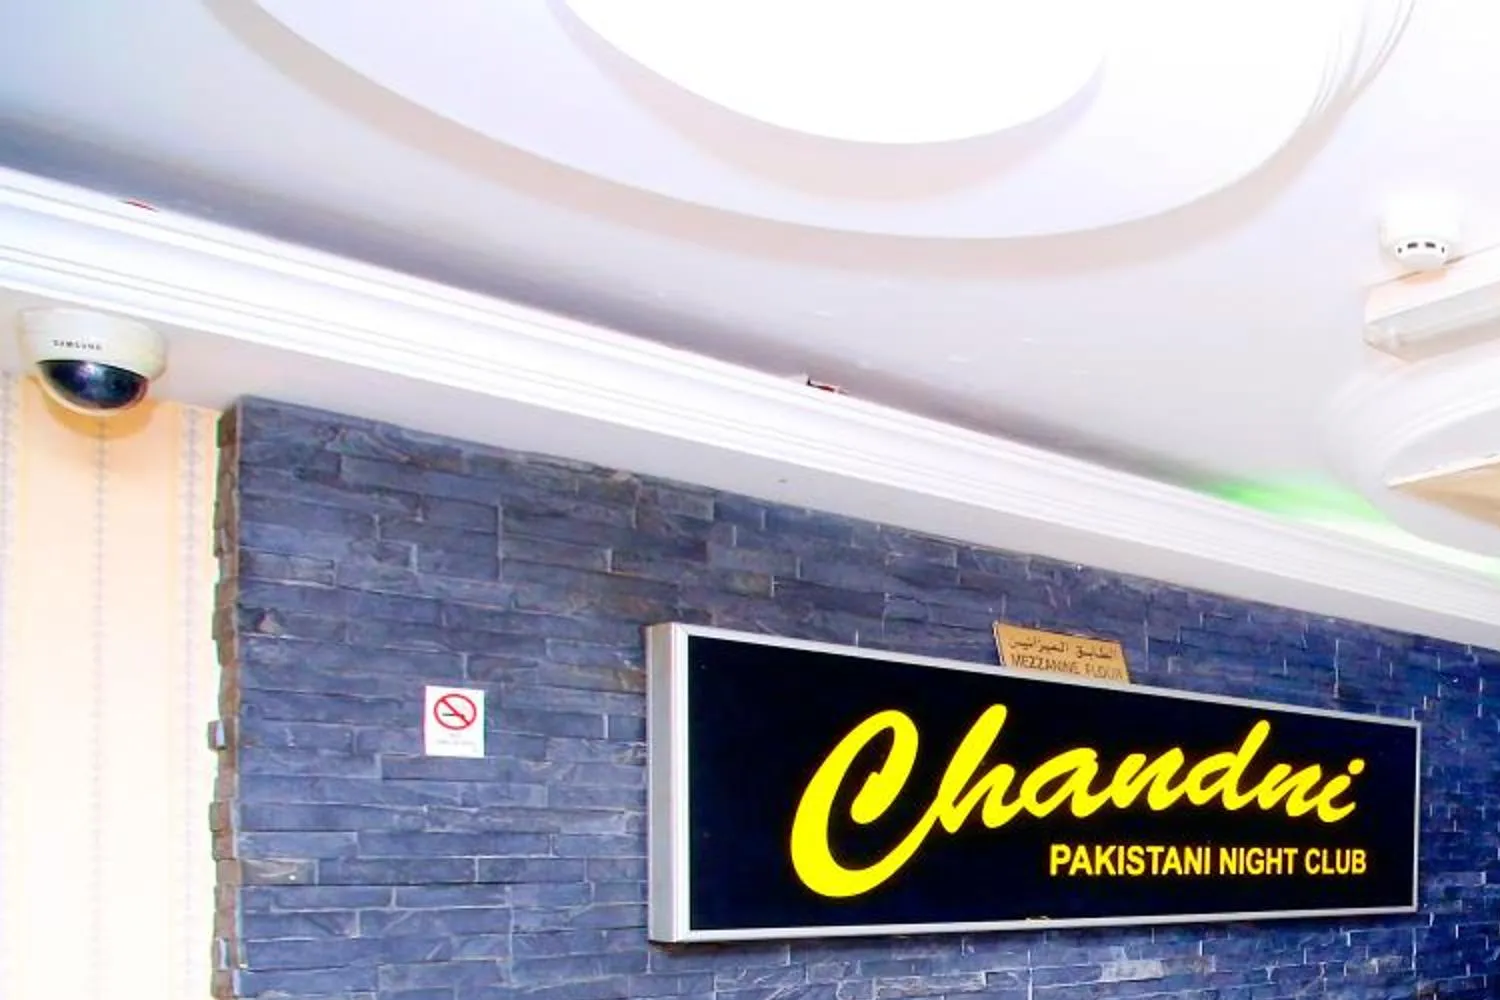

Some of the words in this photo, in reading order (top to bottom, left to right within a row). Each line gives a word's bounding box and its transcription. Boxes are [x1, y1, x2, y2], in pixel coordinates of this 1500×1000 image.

[53, 339, 103, 351] SAMSUNG
[1010, 652, 1081, 675] MEZZANINE
[790, 703, 1365, 898] Chandni
[1049, 843, 1211, 876] PAKISTANI
[1219, 847, 1298, 876] NIGHT
[1304, 847, 1367, 875] CLUB
